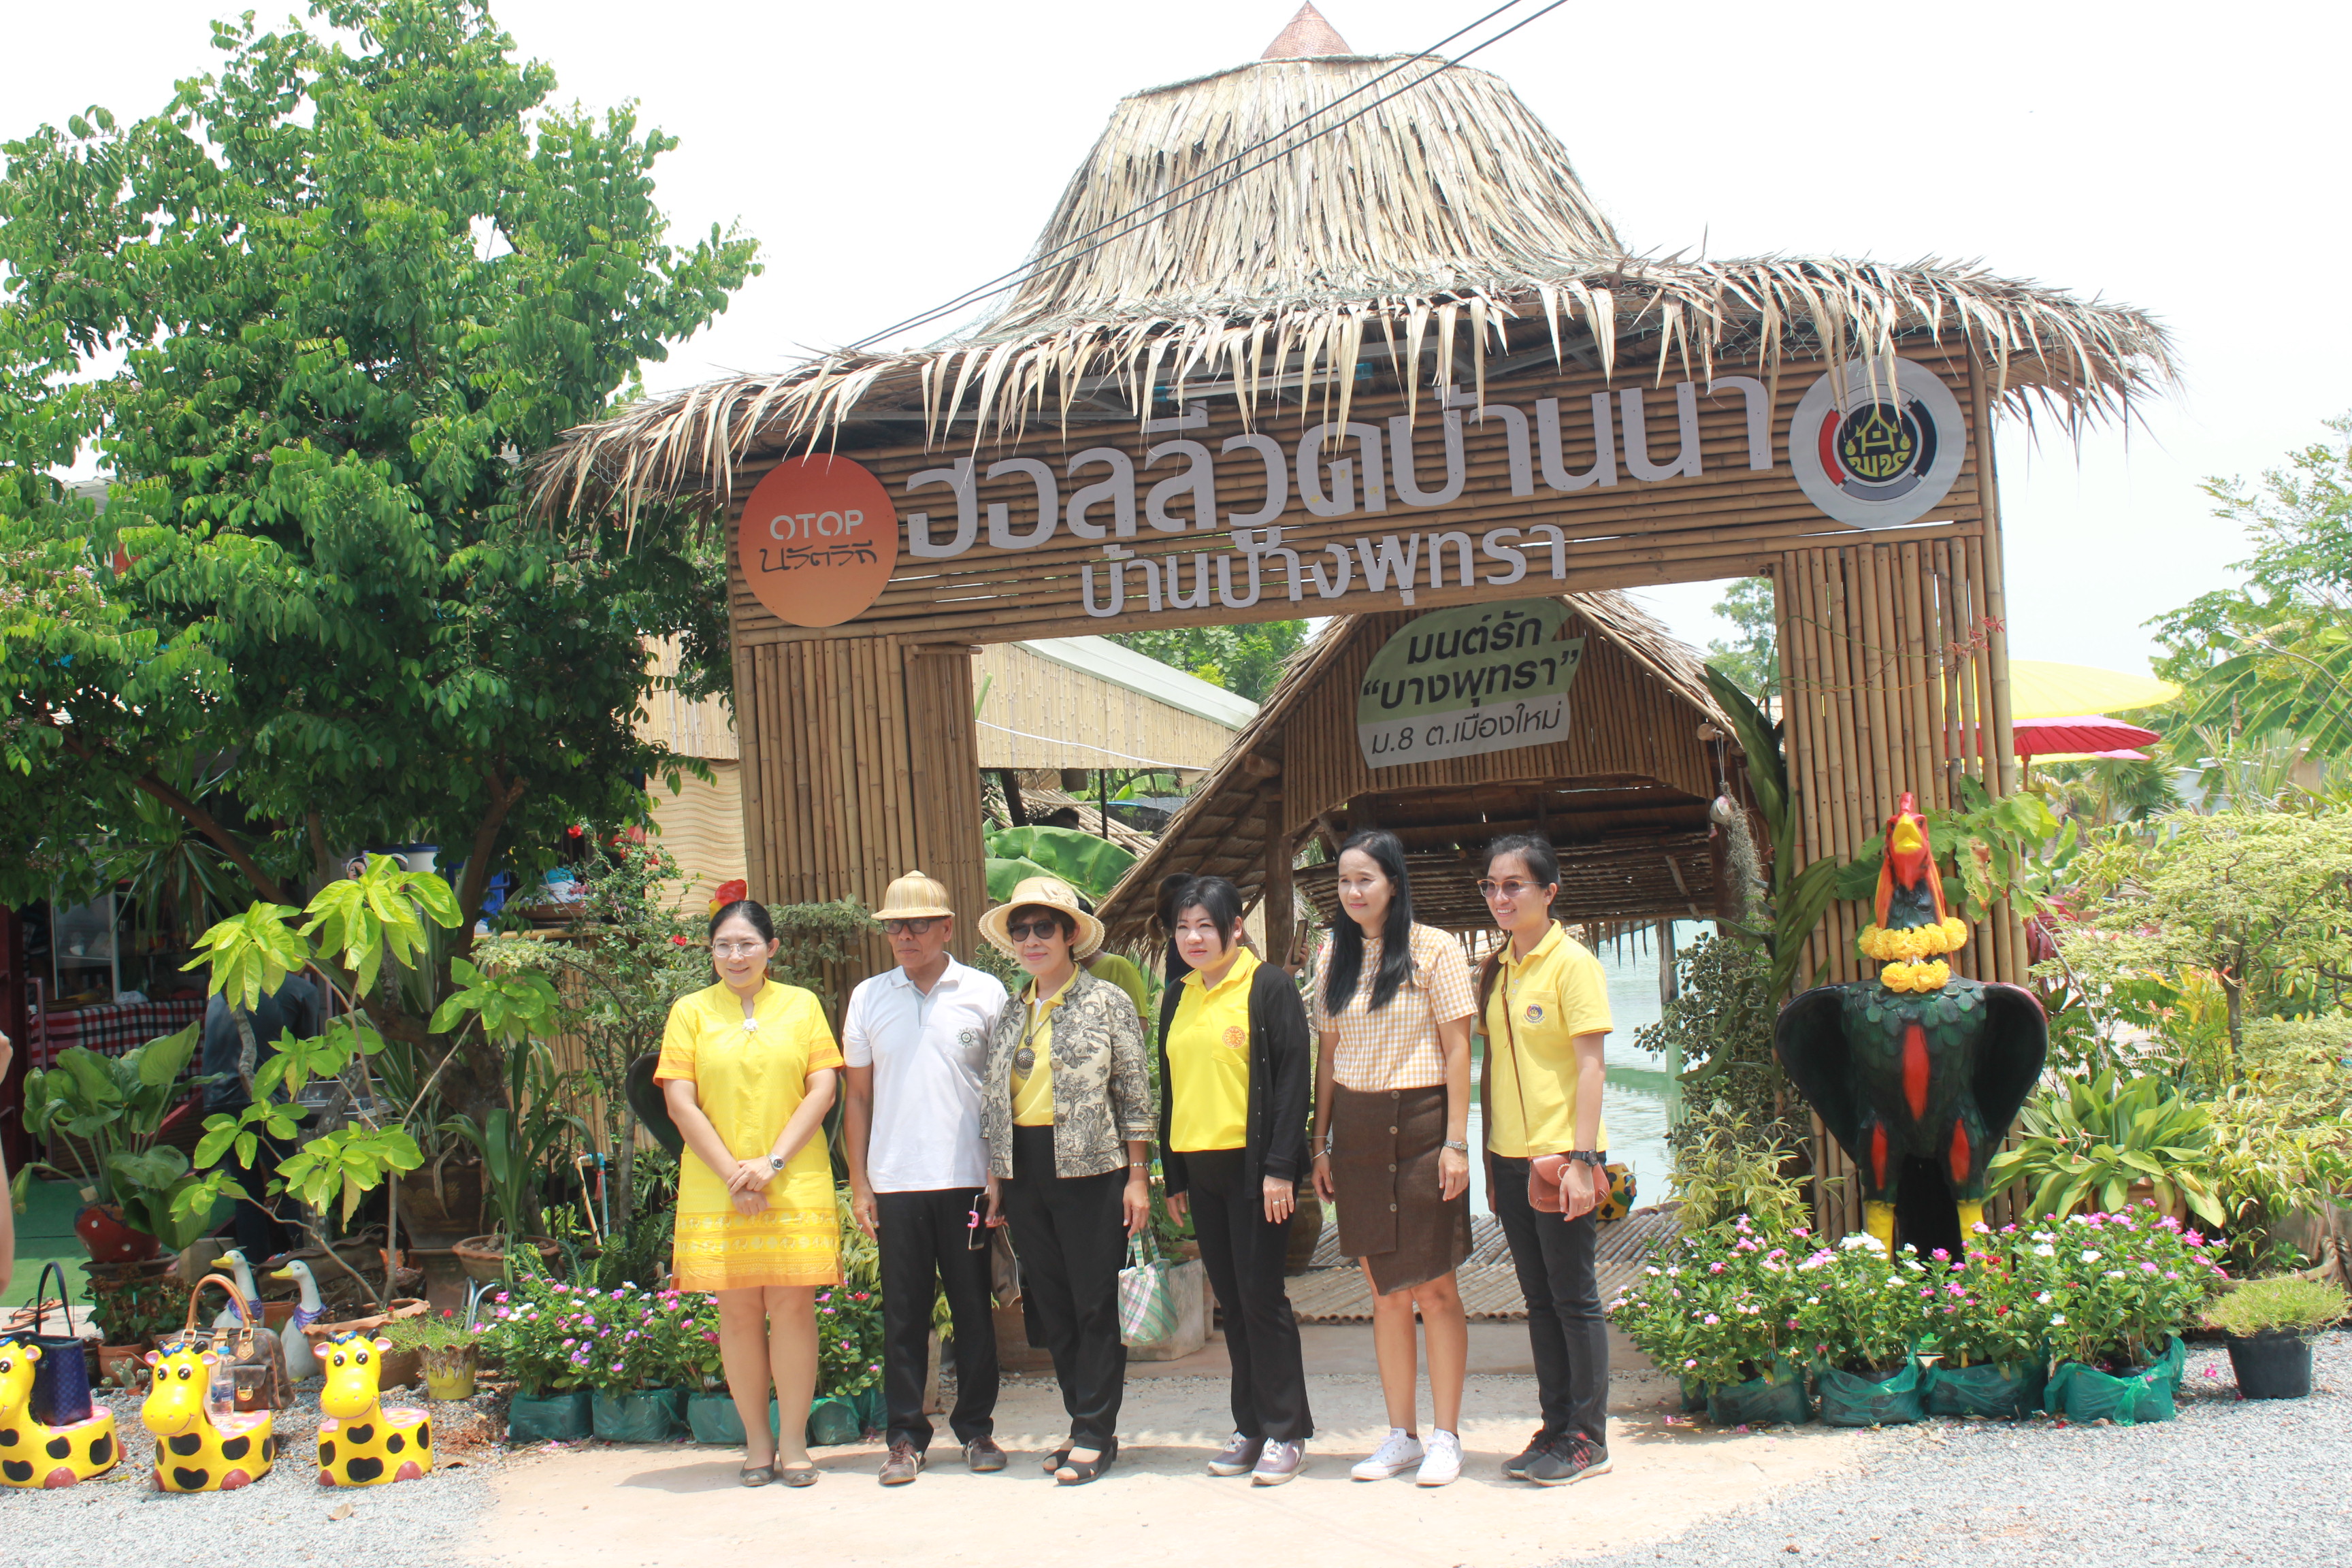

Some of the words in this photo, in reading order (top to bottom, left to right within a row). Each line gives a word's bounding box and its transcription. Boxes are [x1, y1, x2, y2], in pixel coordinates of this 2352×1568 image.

[770, 509, 864, 540] OTOP
[1407, 610, 1544, 664] มนต์รัก
[1371, 726, 1414, 755] ม.8
[1426, 700, 1563, 747] ต.เมืองใหม่
